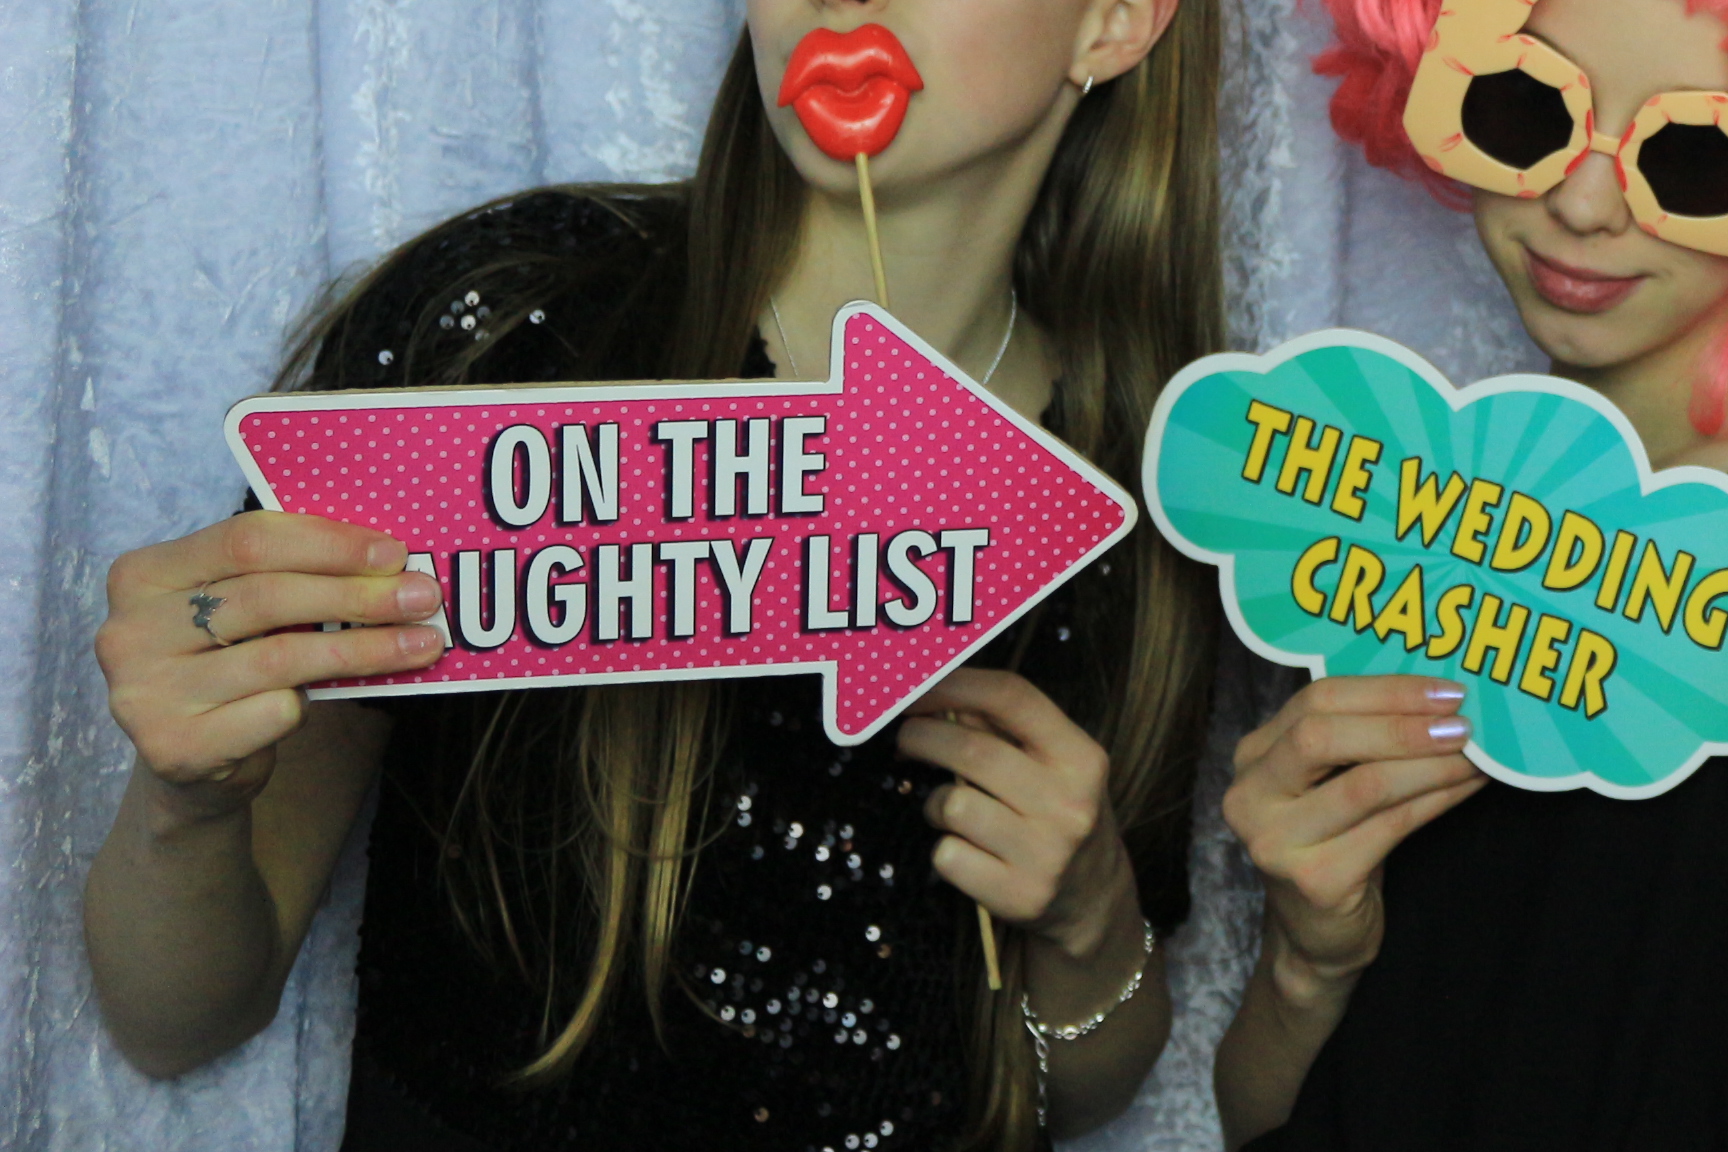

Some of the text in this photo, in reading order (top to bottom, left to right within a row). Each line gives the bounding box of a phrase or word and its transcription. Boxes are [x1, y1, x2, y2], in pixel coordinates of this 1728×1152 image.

[489, 415, 827, 528] ON THE
[1241, 398, 1384, 520] THE
[320, 528, 990, 650] UGHTY LIST
[1290, 535, 1618, 720] CRASHER
